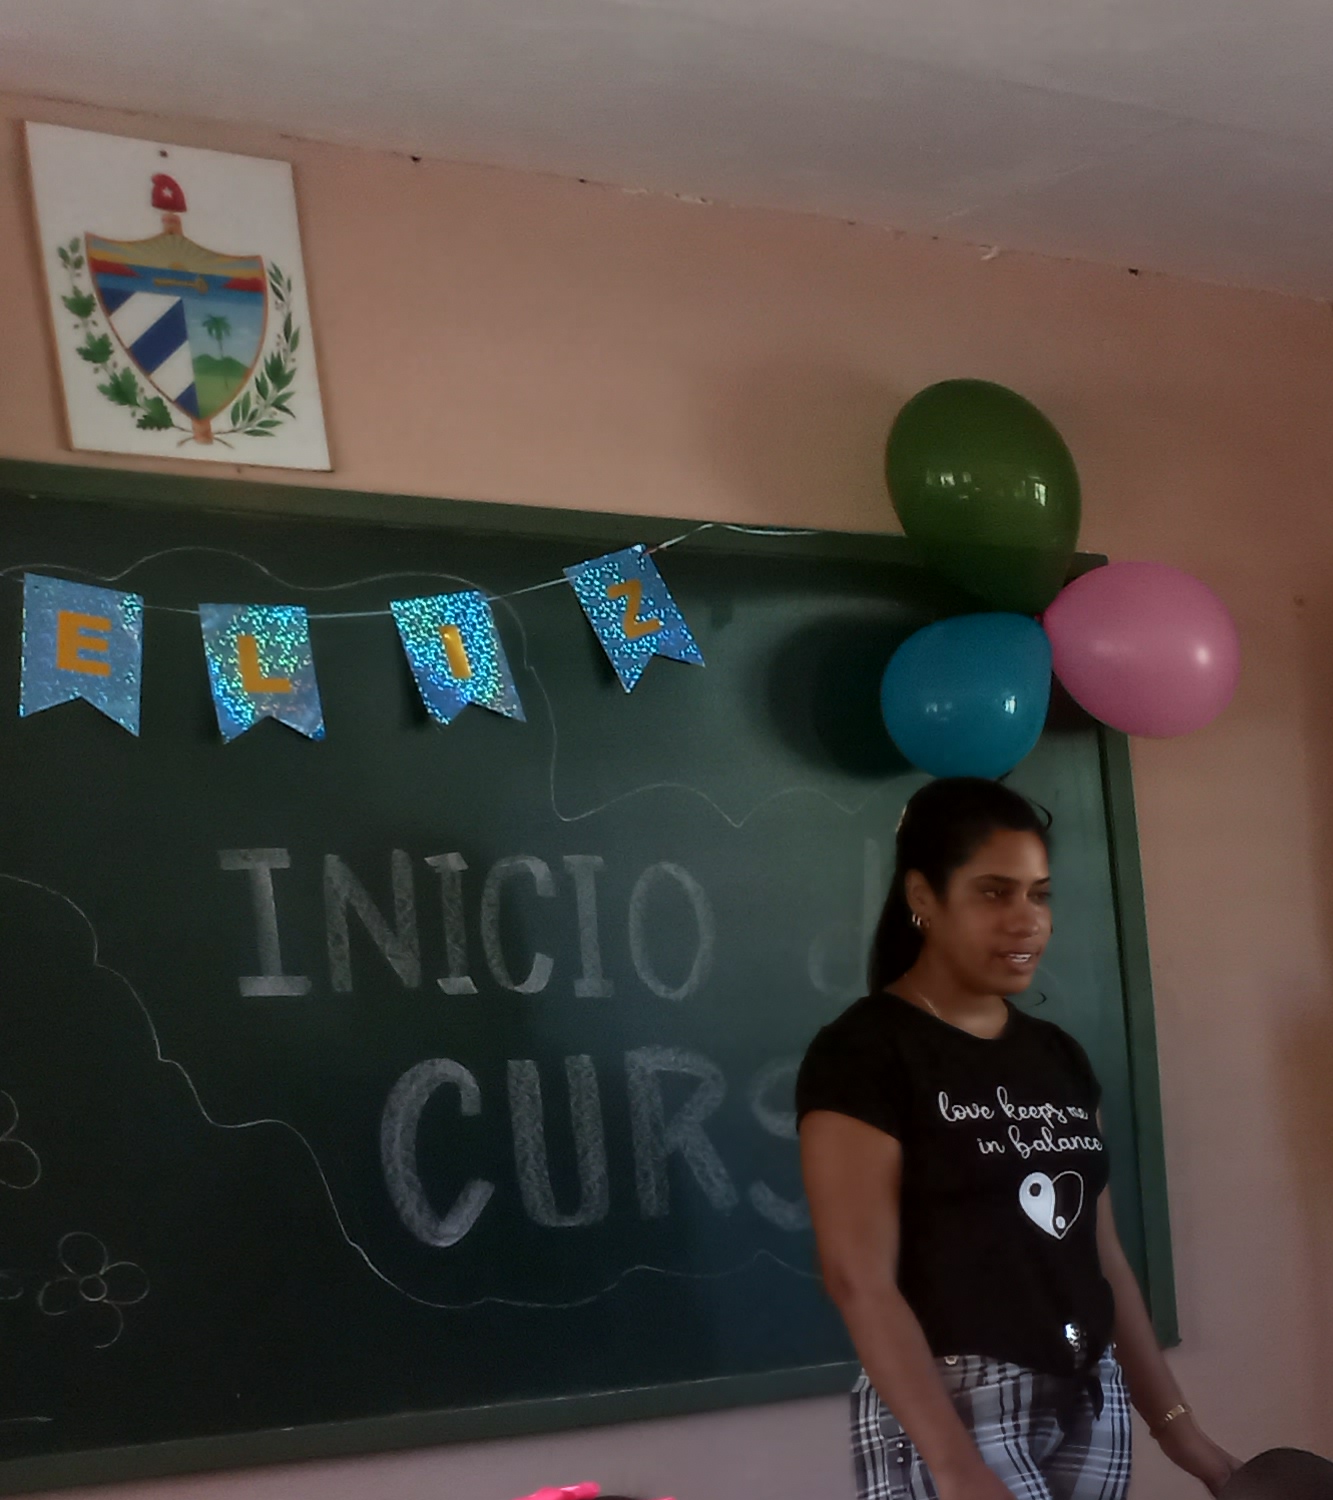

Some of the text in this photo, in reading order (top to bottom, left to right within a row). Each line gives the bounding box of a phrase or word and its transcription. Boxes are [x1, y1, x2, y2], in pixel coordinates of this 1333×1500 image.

[218, 845, 717, 1001] INICIO
[938, 1086, 1089, 1128] love keeps me
[977, 1125, 1103, 1159] in balance
